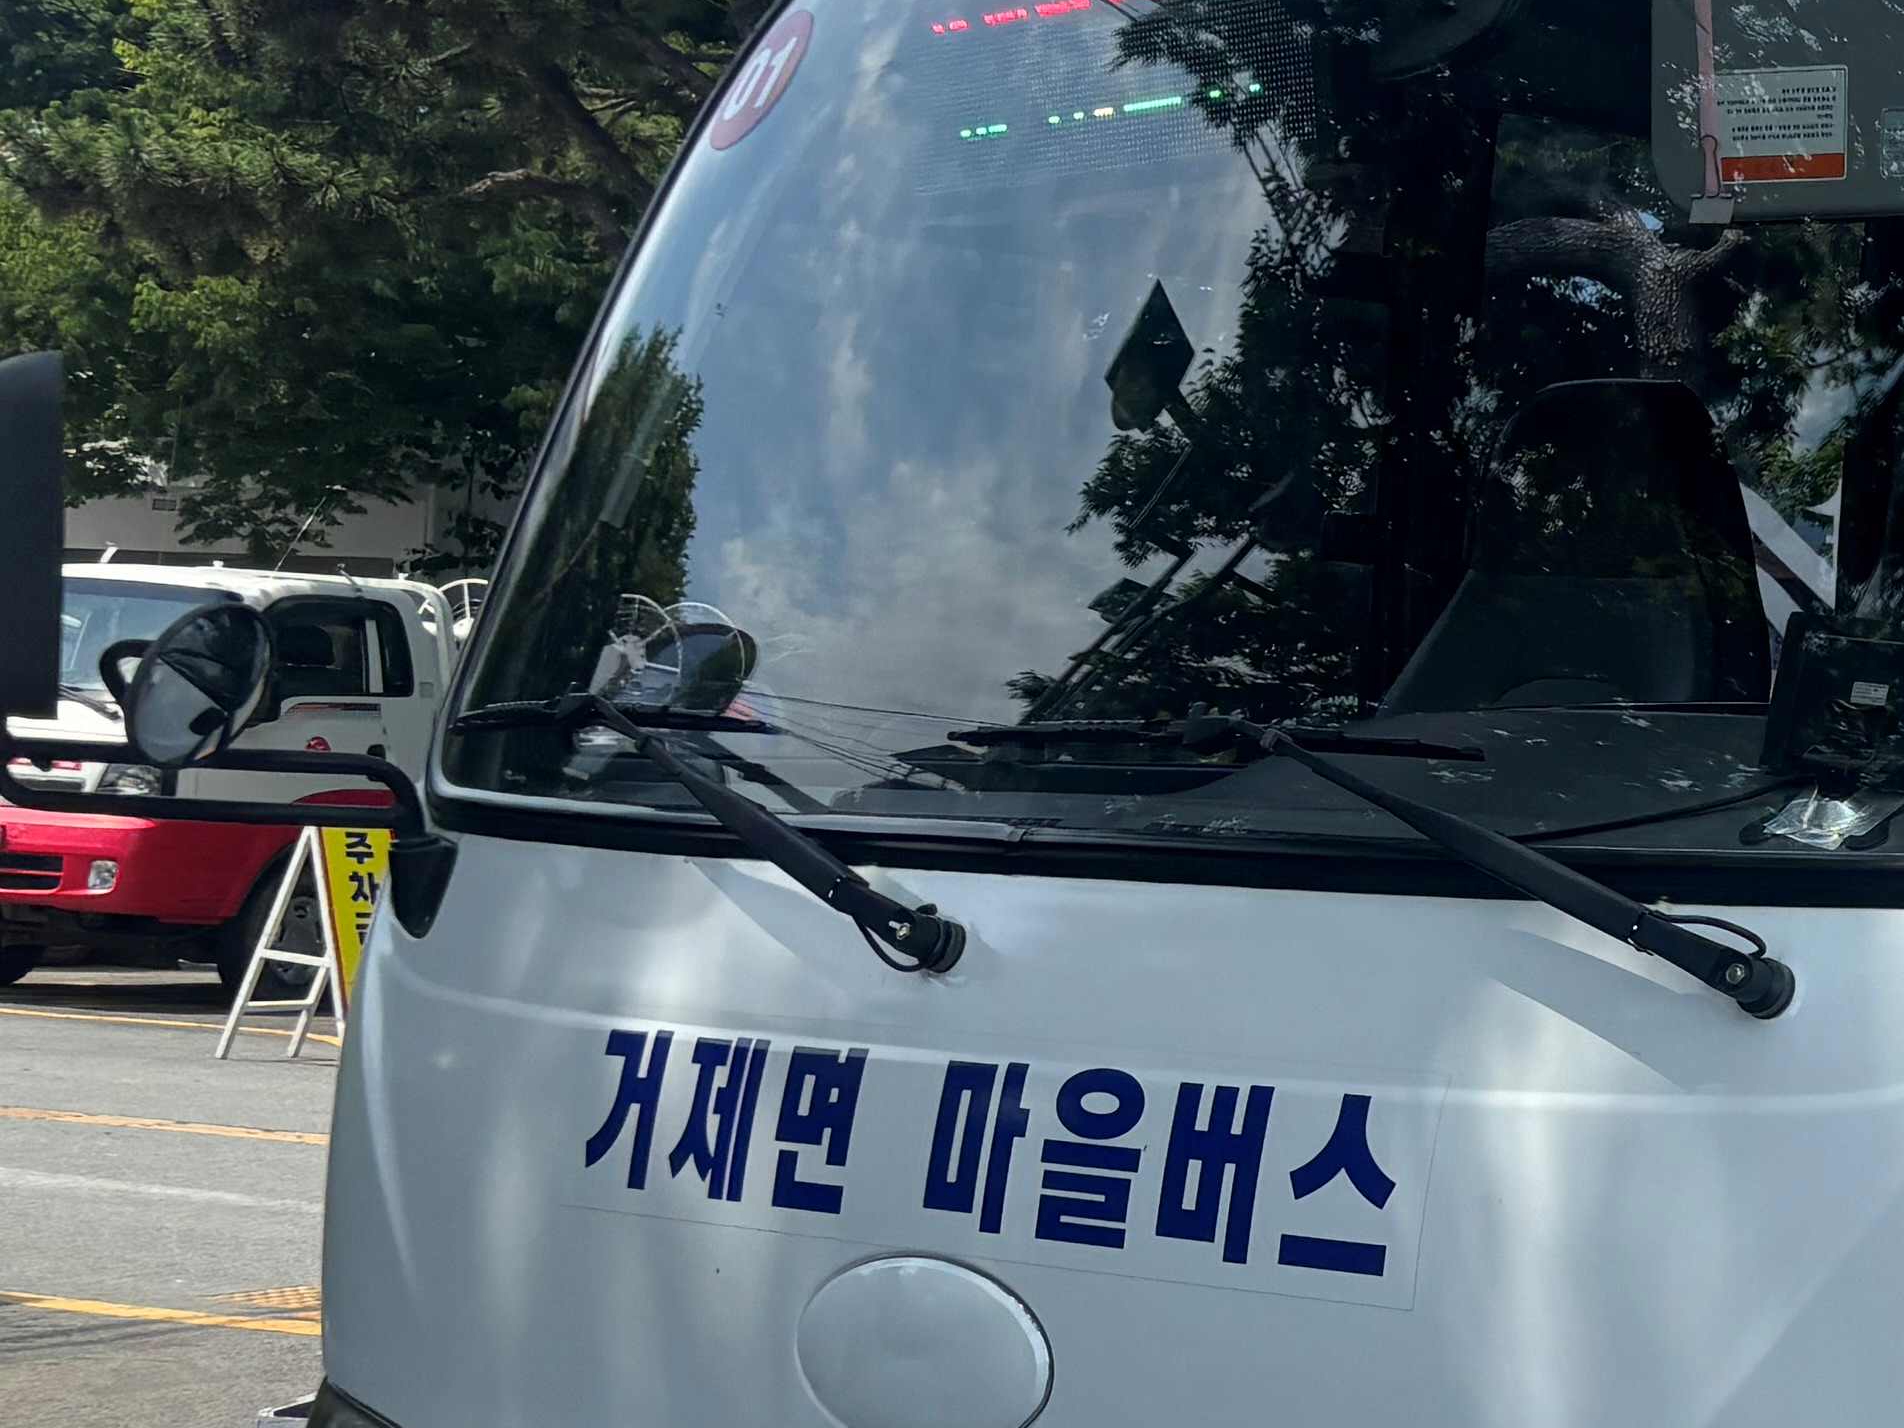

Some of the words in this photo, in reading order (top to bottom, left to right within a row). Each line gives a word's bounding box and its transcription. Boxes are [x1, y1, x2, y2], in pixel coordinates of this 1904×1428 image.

[723, 37, 798, 121] 01
[585, 1029, 870, 1215] 거제면
[923, 1060, 1397, 1278] 마을버스
